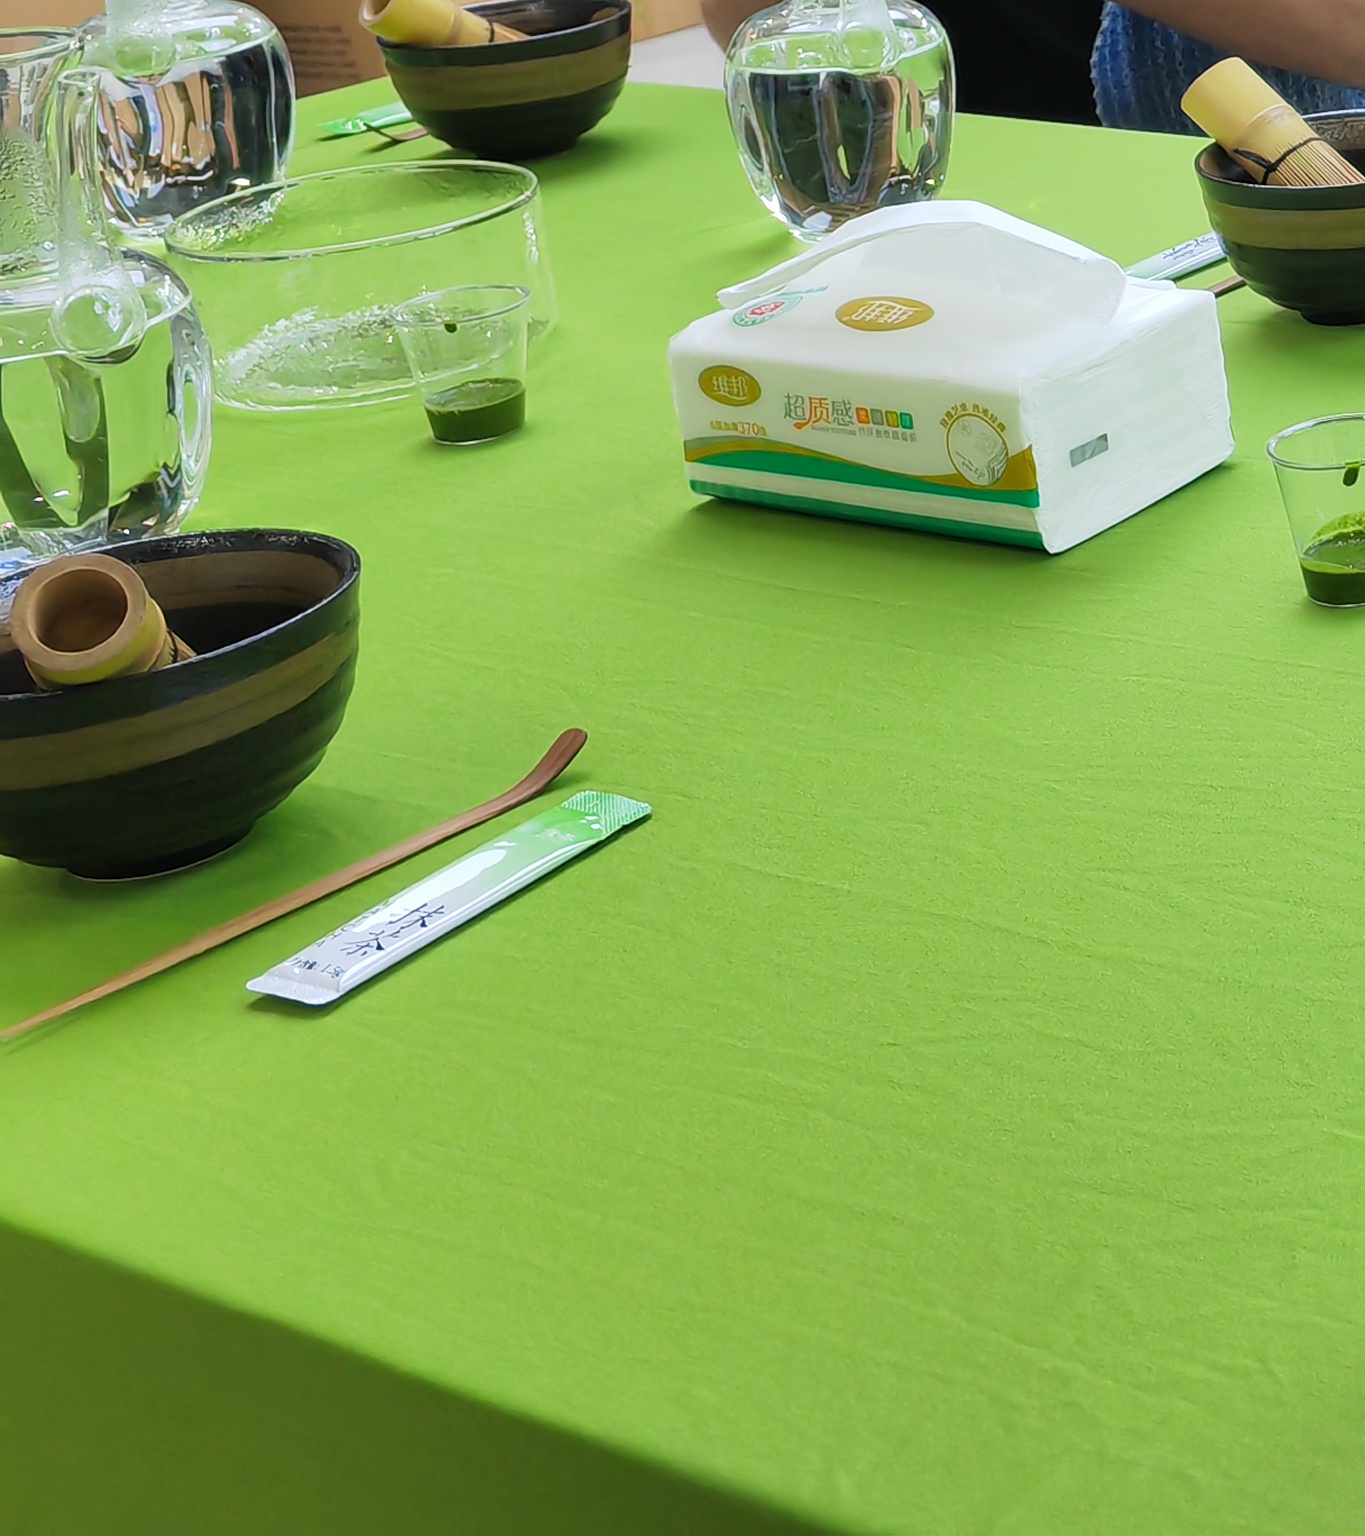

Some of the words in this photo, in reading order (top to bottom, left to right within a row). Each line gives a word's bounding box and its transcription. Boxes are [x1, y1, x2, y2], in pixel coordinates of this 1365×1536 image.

[784, 392, 855, 430] 超质感
[340, 902, 446, 957] 抹茶
